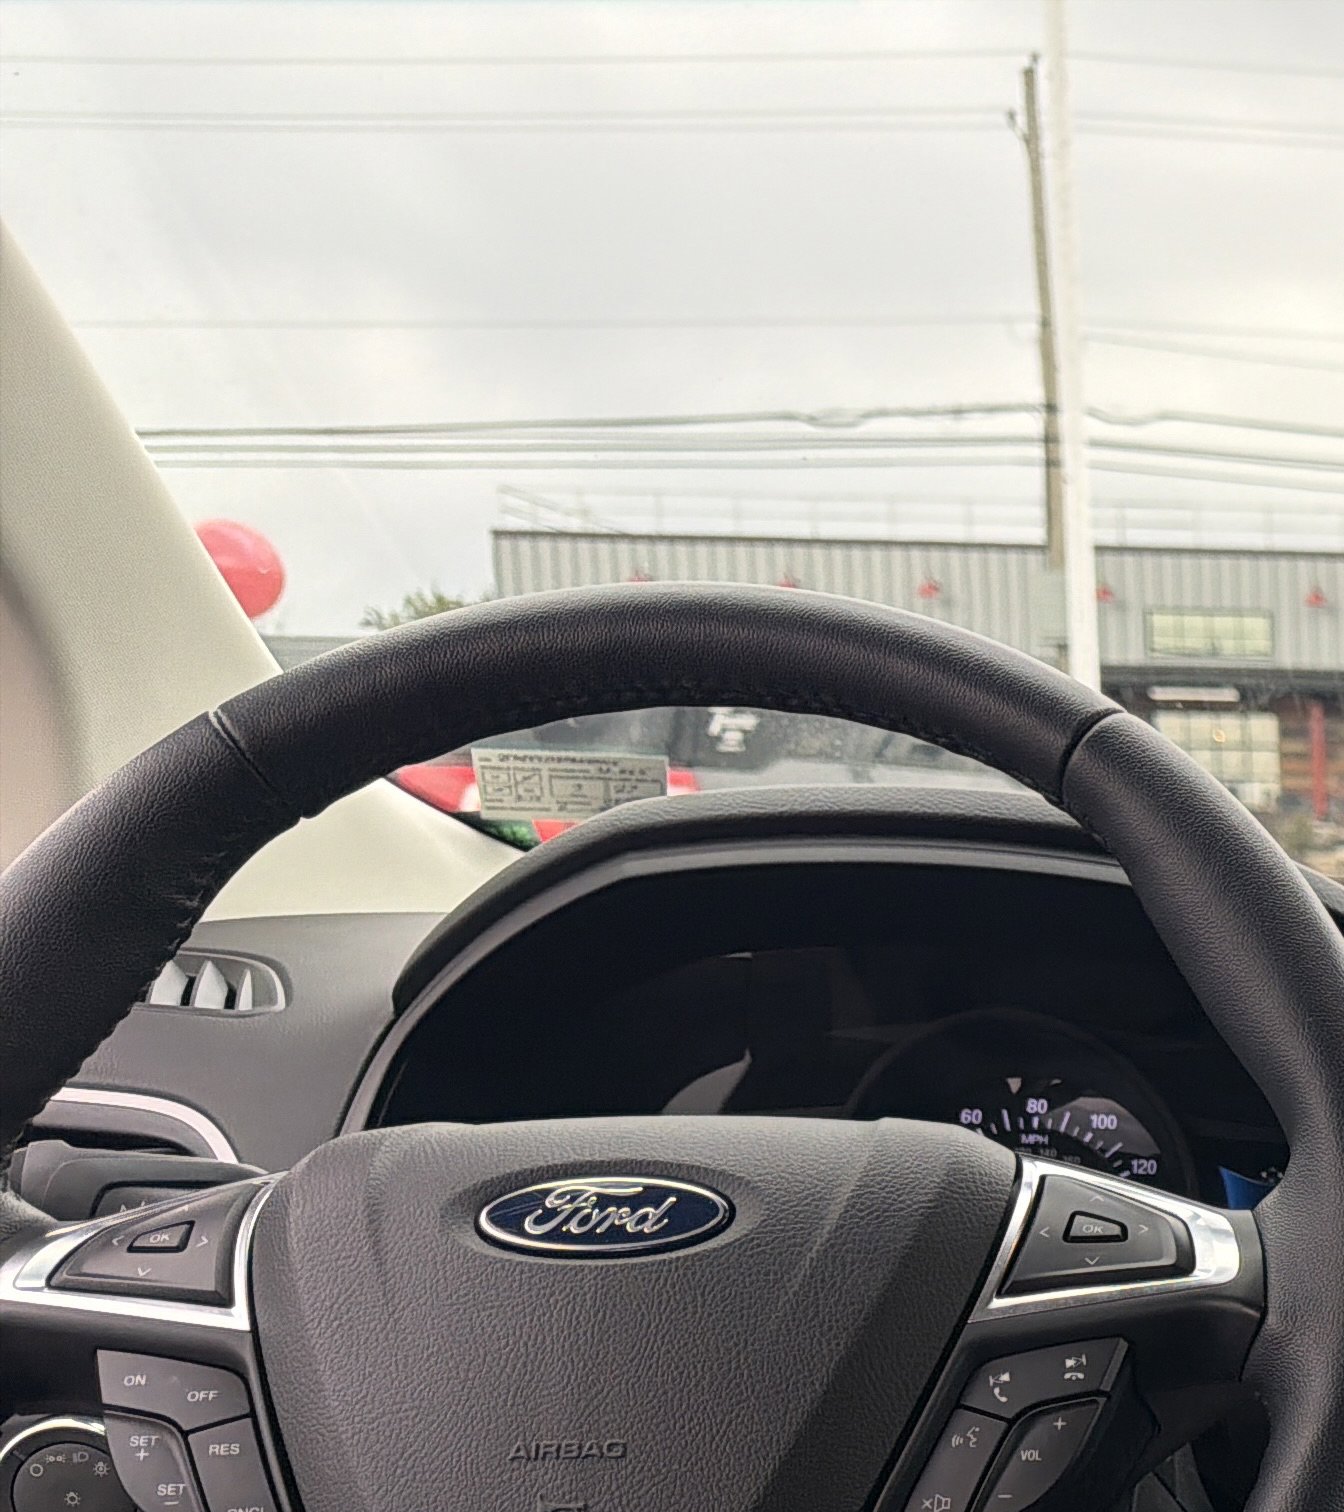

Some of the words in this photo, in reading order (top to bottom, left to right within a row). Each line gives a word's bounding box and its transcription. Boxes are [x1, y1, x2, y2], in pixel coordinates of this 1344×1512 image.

[1026, 1098, 1048, 1114] 80
[960, 1109, 982, 1125] 60
[1090, 1113, 1118, 1130] 100
[1021, 1134, 1049, 1146] MPH
[1130, 1158, 1157, 1175] 120
[523, 1185, 677, 1235] Ford
[1082, 1223, 1104, 1235] OK
[148, 1231, 171, 1244] OK
[123, 1374, 146, 1388] ON
[186, 1389, 219, 1403] OFF
[129, 1435, 160, 1448] SET
[208, 1443, 240, 1457] RES
[508, 1439, 628, 1461] AIRBAG
[1020, 1450, 1042, 1462] VOL
[157, 1483, 186, 1497] SET
